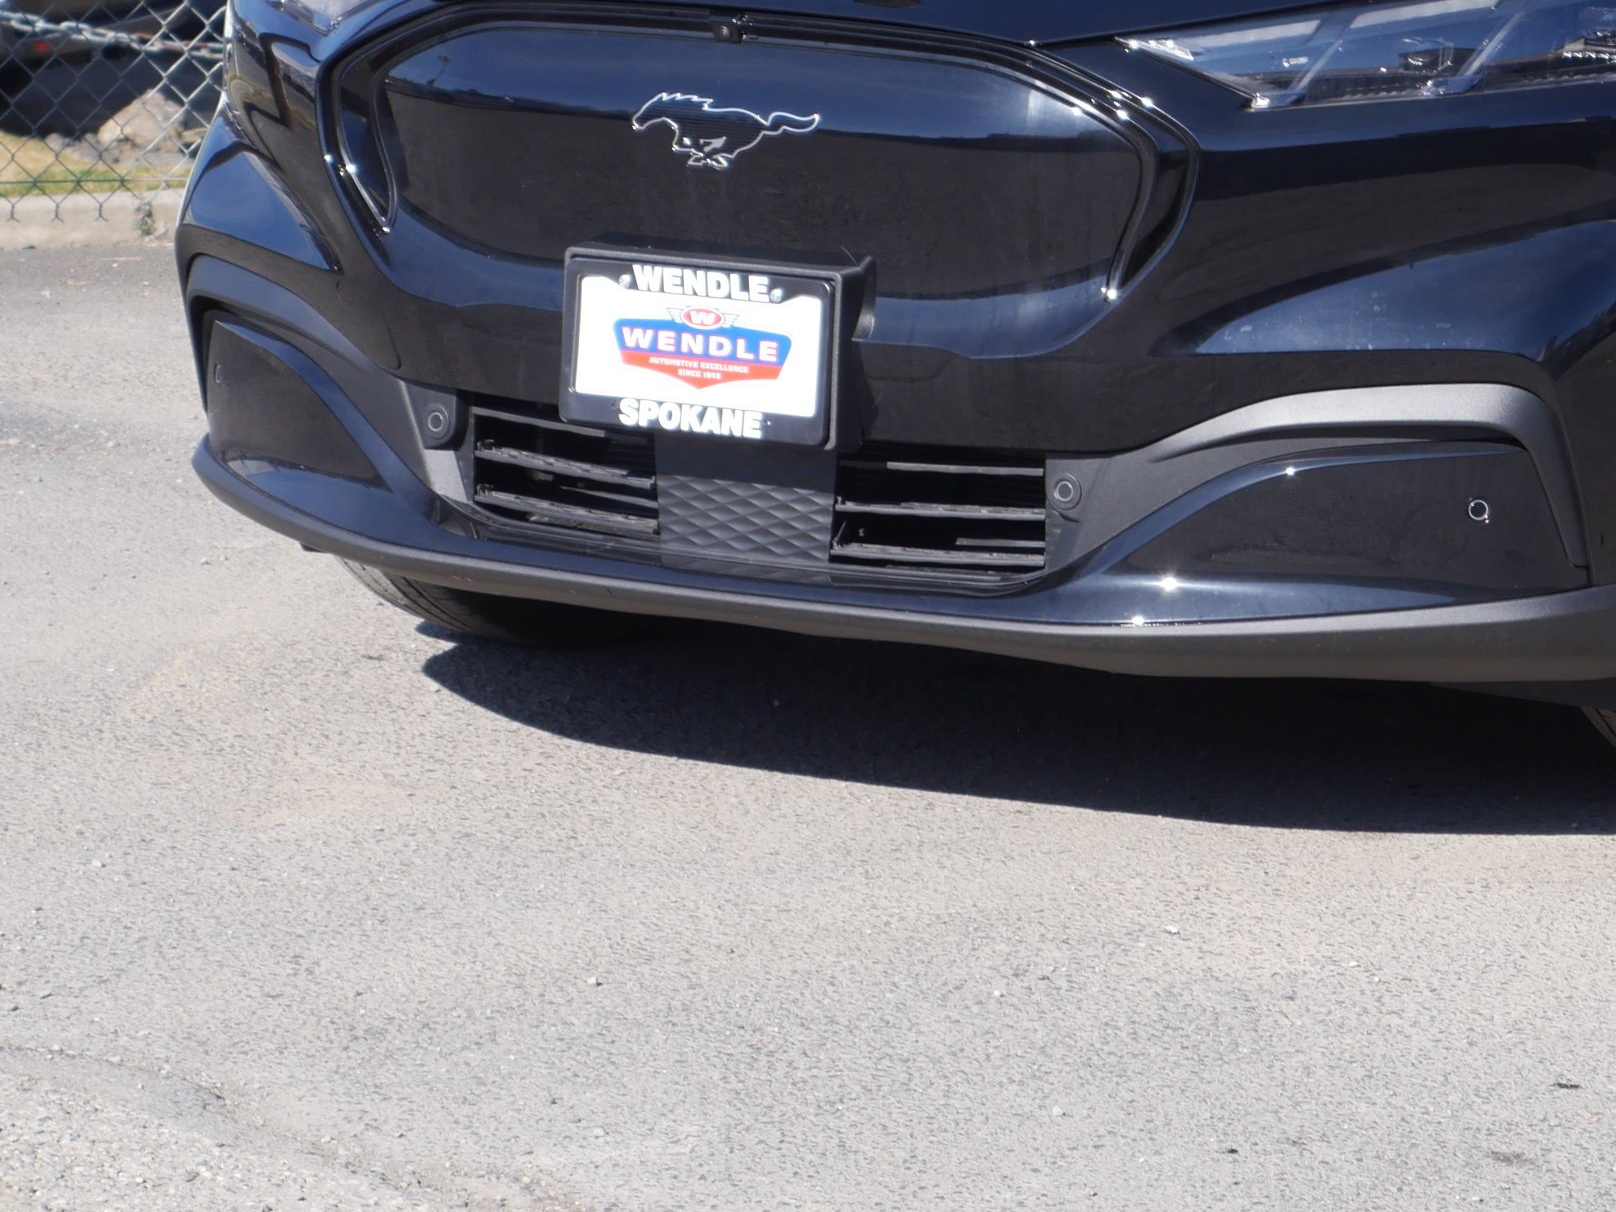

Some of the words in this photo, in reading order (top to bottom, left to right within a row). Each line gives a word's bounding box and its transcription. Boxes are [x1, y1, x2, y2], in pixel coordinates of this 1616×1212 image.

[632, 264, 770, 303] WENDLE
[690, 310, 715, 326] W
[621, 327, 778, 362] WENDLE
[649, 356, 699, 369] AUTOMOTIVE
[700, 361, 750, 374] EXCELLENCE
[677, 368, 701, 378] SINCE
[618, 398, 762, 439] SPOKANE
